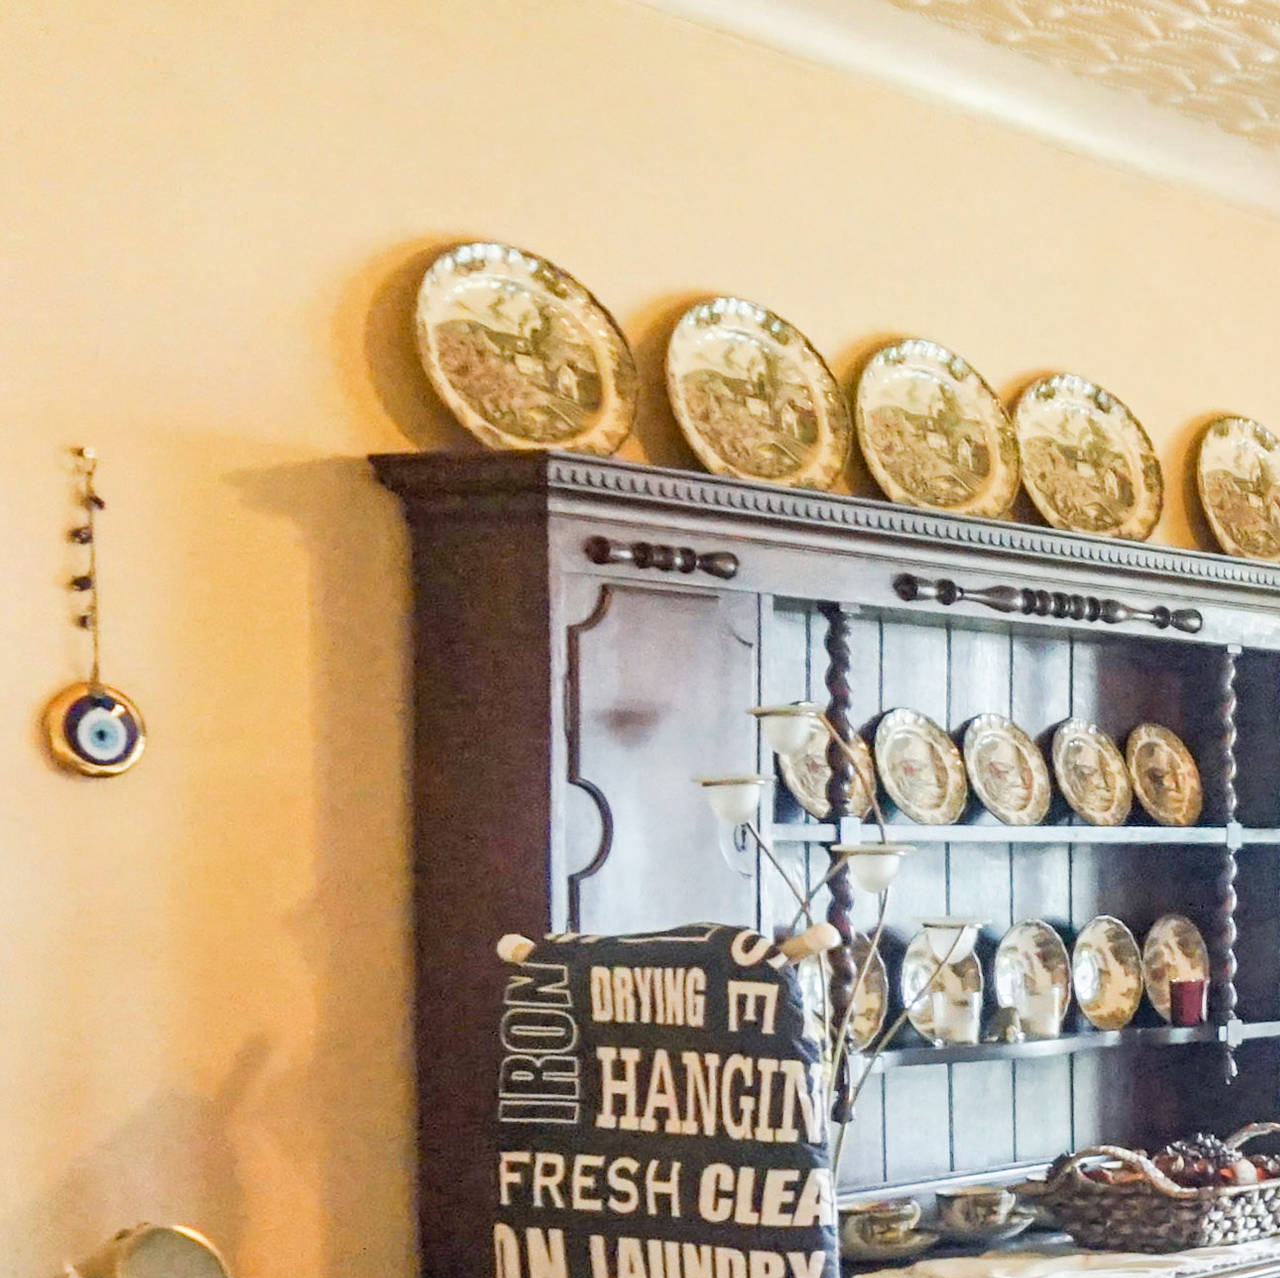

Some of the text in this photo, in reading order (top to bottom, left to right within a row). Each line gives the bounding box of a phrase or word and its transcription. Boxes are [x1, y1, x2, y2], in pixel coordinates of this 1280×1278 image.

[590, 966, 706, 1028] DRYING
[499, 962, 580, 1125] IRON
[595, 1046, 823, 1144] HANGIN
[499, 1150, 834, 1228] FRESH CLEA
